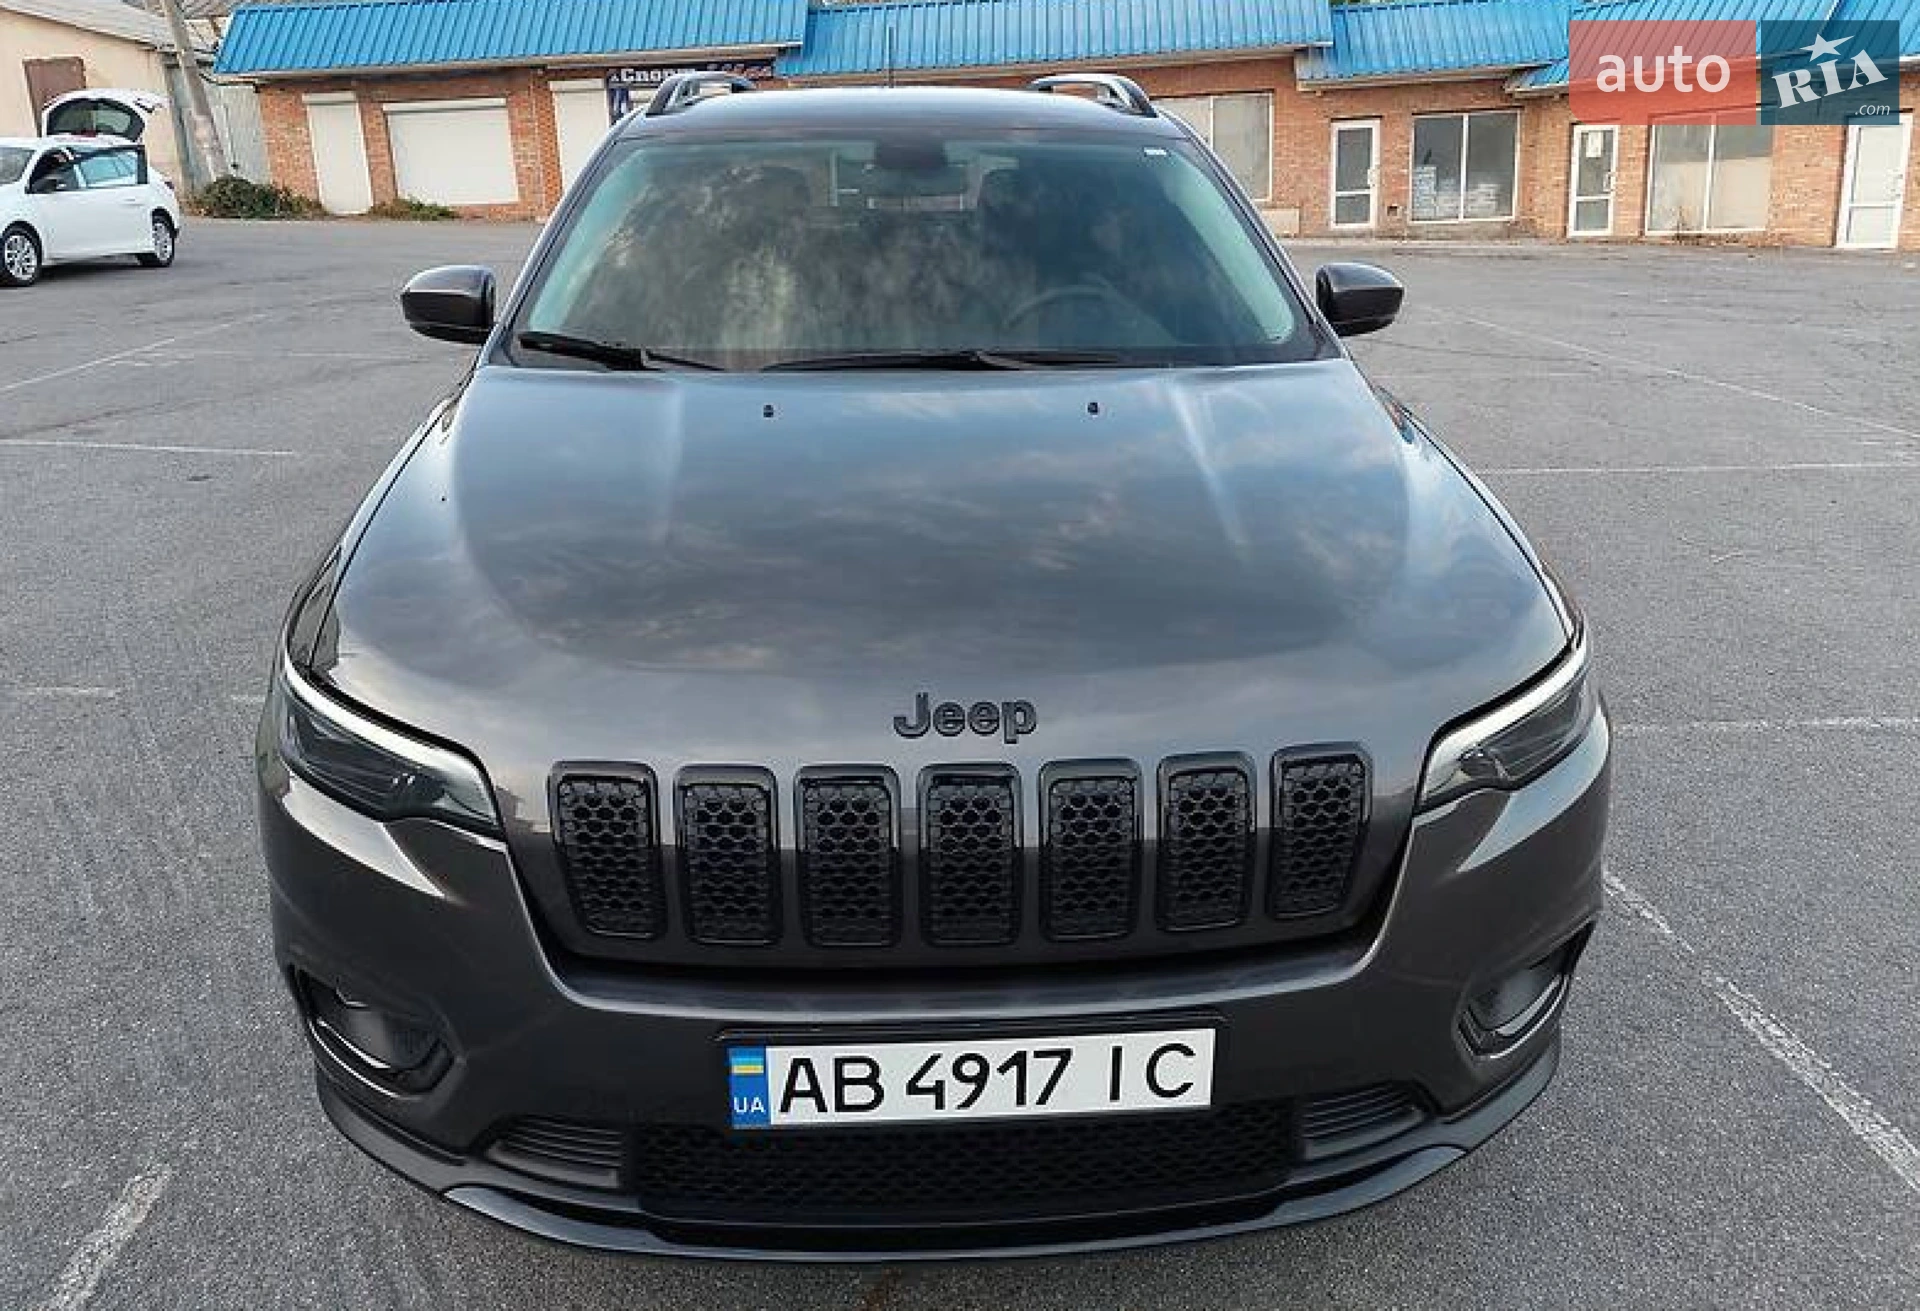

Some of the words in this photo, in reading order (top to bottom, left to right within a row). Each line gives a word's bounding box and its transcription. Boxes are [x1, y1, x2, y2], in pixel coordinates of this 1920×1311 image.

[893, 692, 1037, 745] Jeep
[733, 1096, 765, 1113] UA
[779, 1056, 885, 1113] AB
[905, 1048, 1074, 1111] 4917
